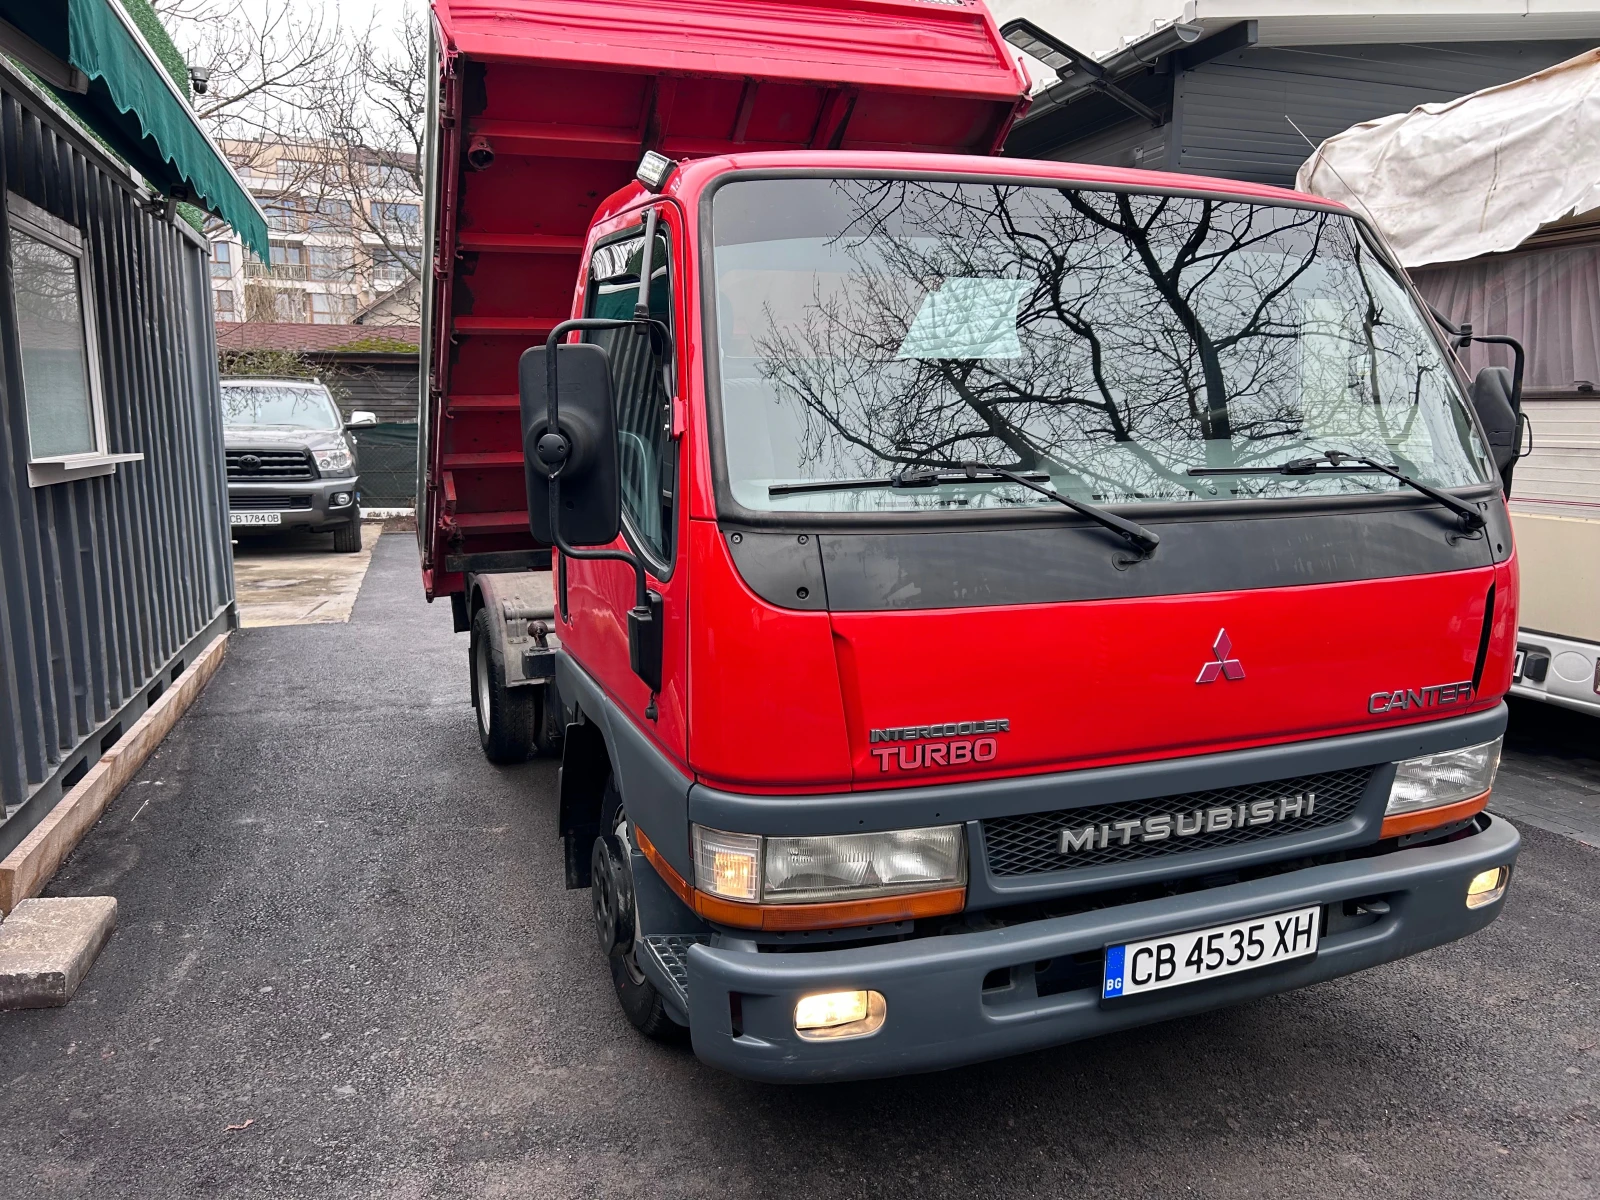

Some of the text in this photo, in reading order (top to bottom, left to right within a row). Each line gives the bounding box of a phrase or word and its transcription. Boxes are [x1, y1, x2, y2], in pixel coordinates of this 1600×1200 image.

[230, 514, 242, 523] CB
[244, 514, 266, 523] 1784
[1368, 680, 1473, 714] CANTER
[870, 718, 1010, 743] INTERCOOLER
[871, 737, 998, 772] TURBO
[1058, 792, 1316, 853] MITSUBISHI
[1131, 912, 1314, 986] CB 4535 XH
[1106, 977, 1122, 991] BG
